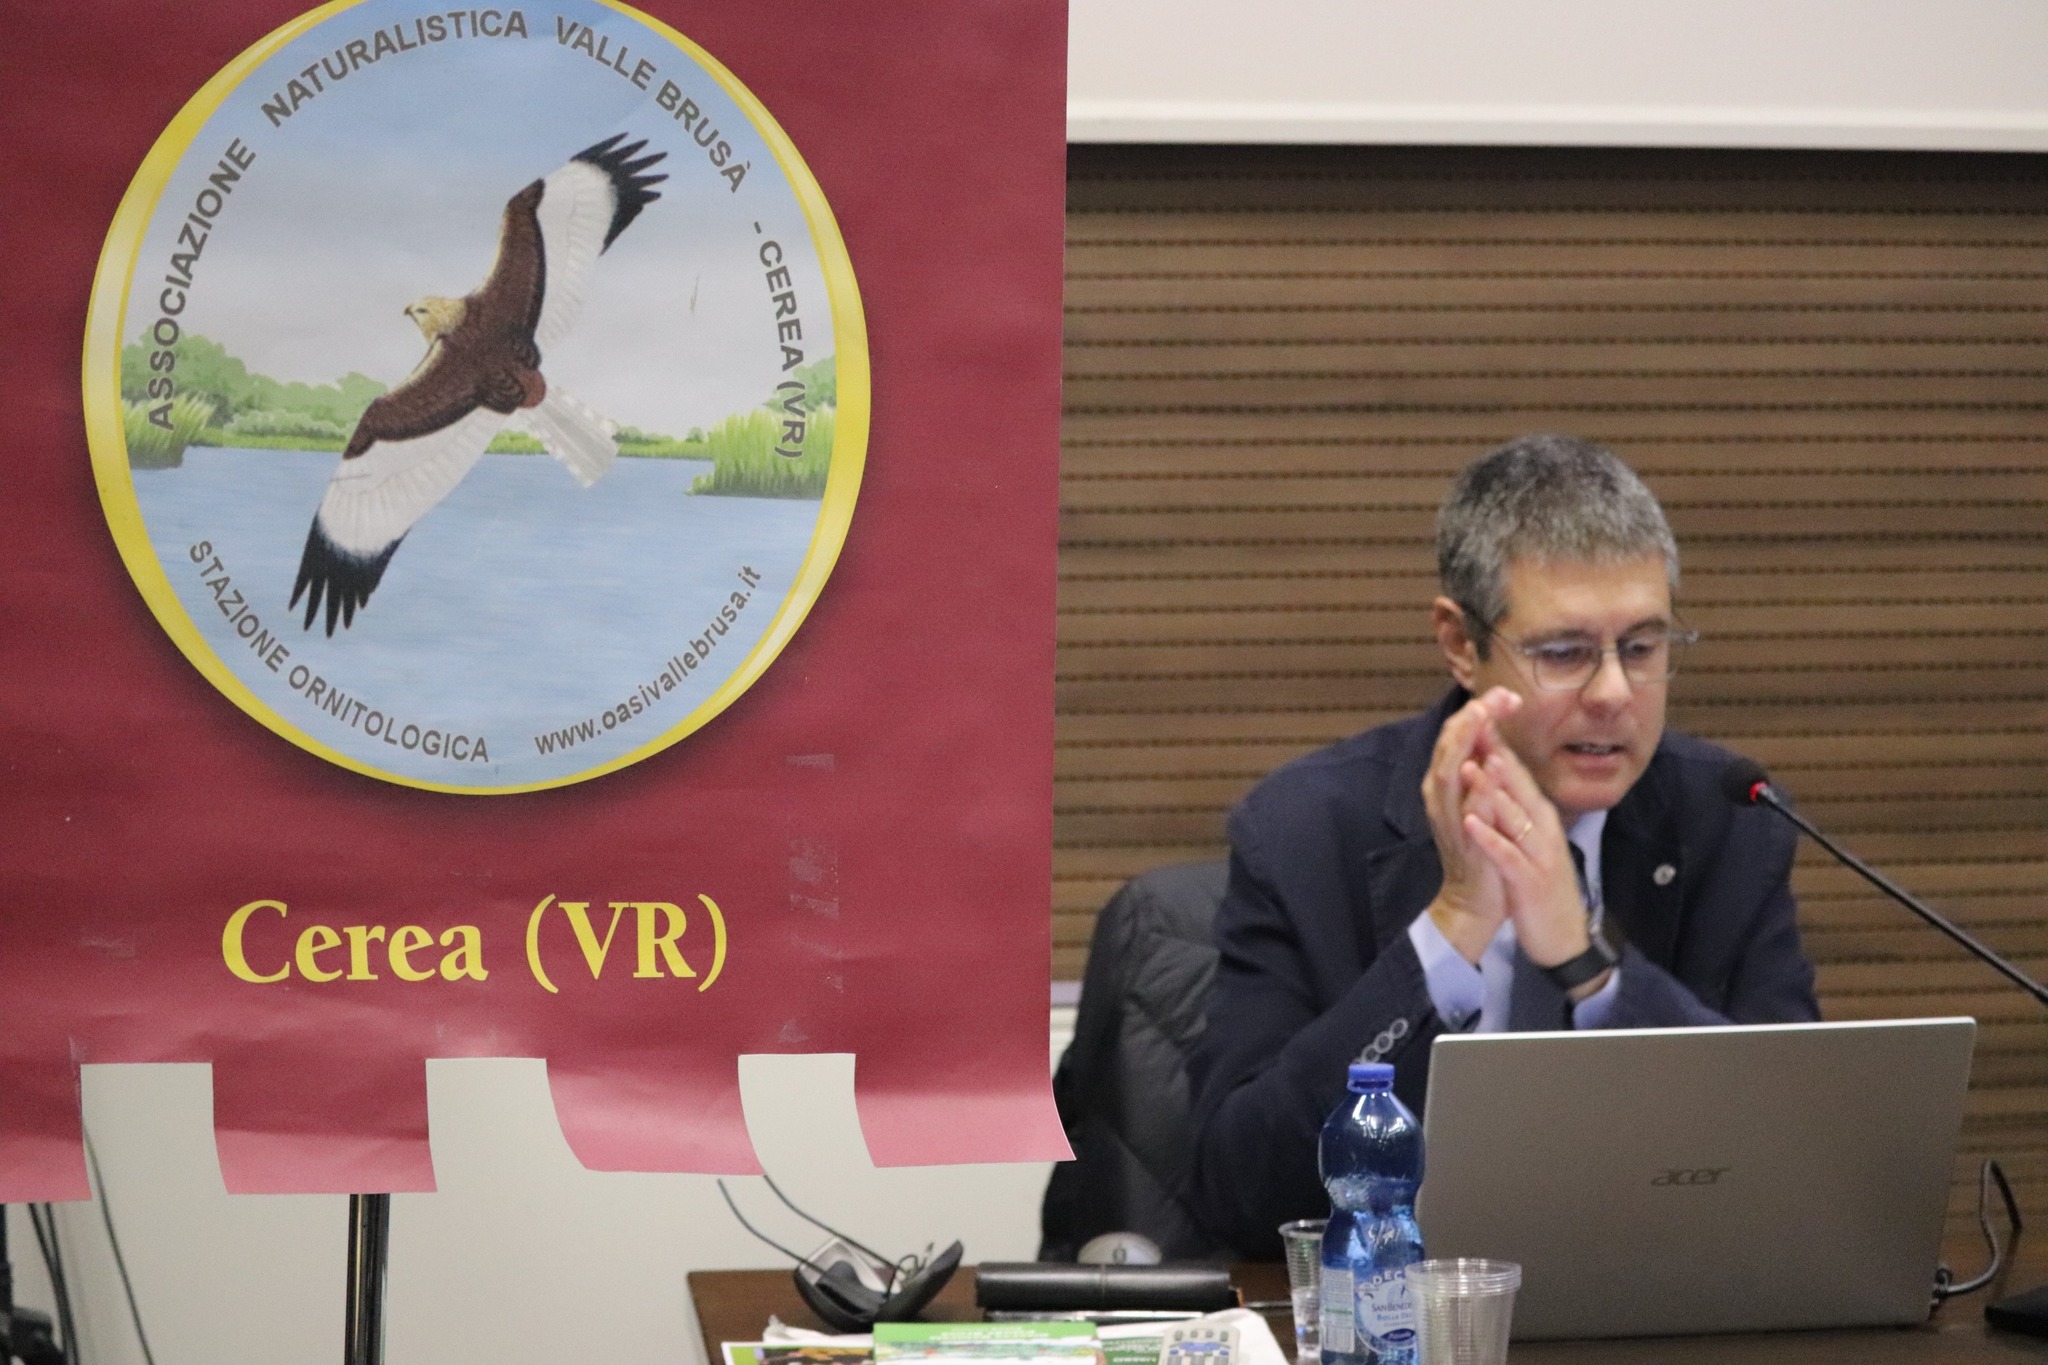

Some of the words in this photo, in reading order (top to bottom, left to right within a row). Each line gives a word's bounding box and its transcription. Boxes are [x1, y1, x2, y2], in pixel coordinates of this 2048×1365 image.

[260, 9, 528, 128] NATURALISTICA
[555, 16, 657, 91] VALLE
[655, 79, 751, 193] BRUSÀ
[149, 137, 256, 432] ASSOCIAZIONE
[760, 240, 804, 372] CEREA
[774, 381, 807, 459] (VR)
[189, 540, 290, 673] STAZIONE
[288, 664, 490, 764] ORNITOLOGICA
[534, 564, 762, 756] www.oasivallebrusa.it
[221, 899, 489, 983] Cerea
[526, 893, 727, 993] (VR)
[1650, 1165, 1732, 1187] acer
